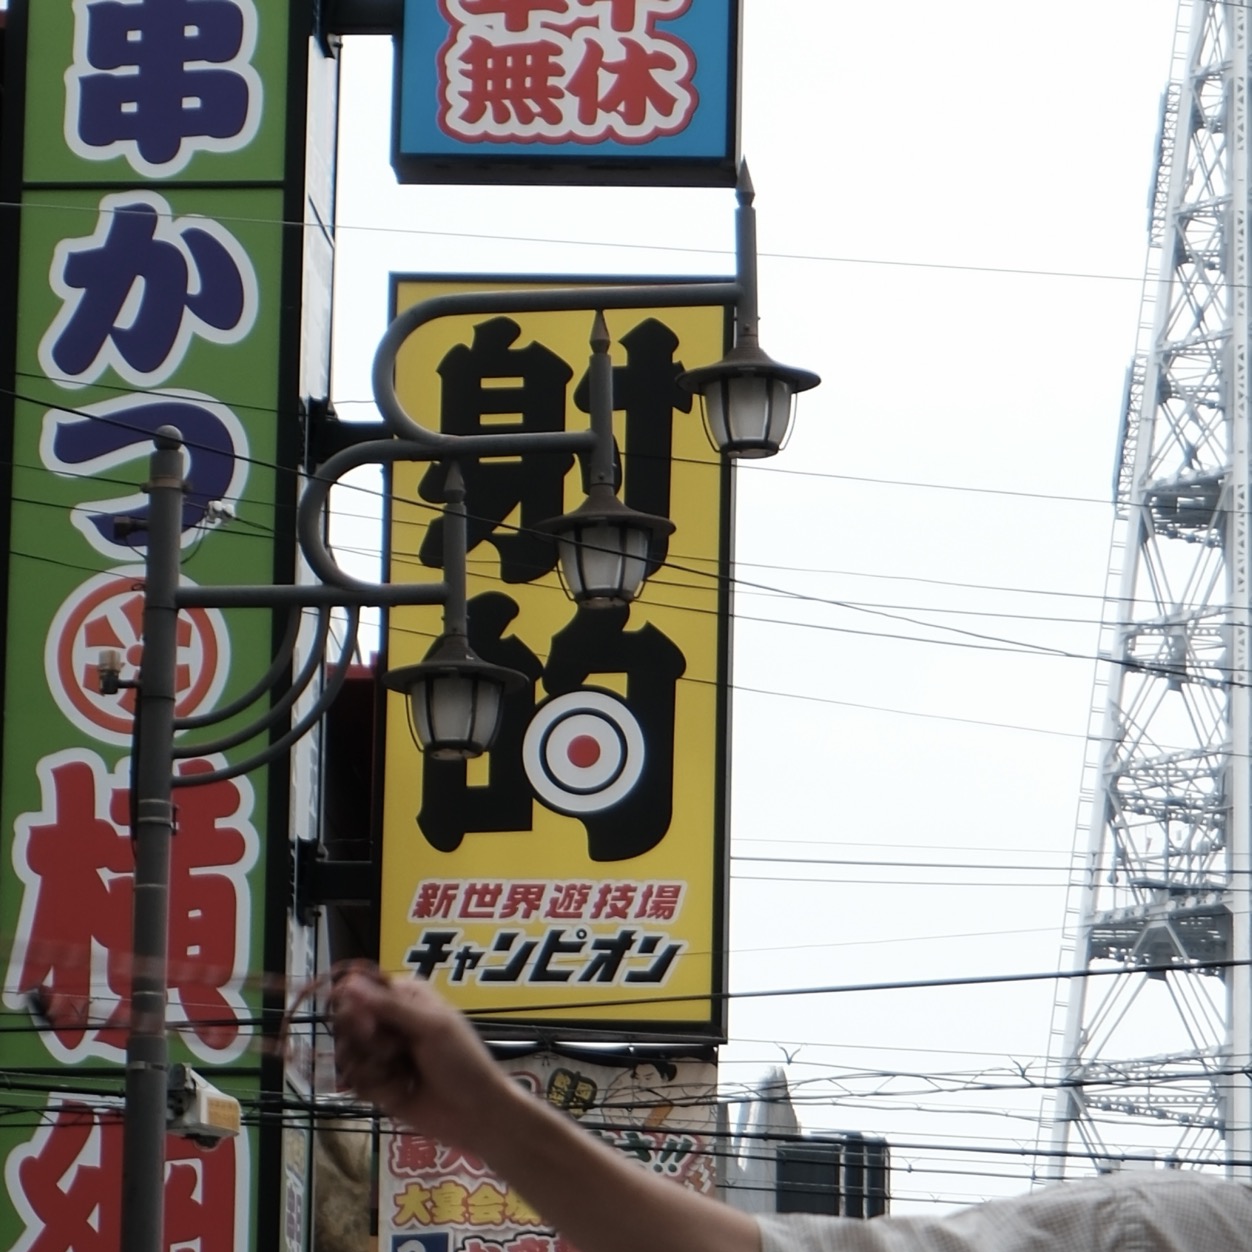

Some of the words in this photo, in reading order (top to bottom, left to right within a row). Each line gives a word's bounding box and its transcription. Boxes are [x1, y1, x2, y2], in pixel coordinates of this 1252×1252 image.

[411, 883, 682, 920] 新世界遊技場
[407, 928, 684, 983] チャンピオン
